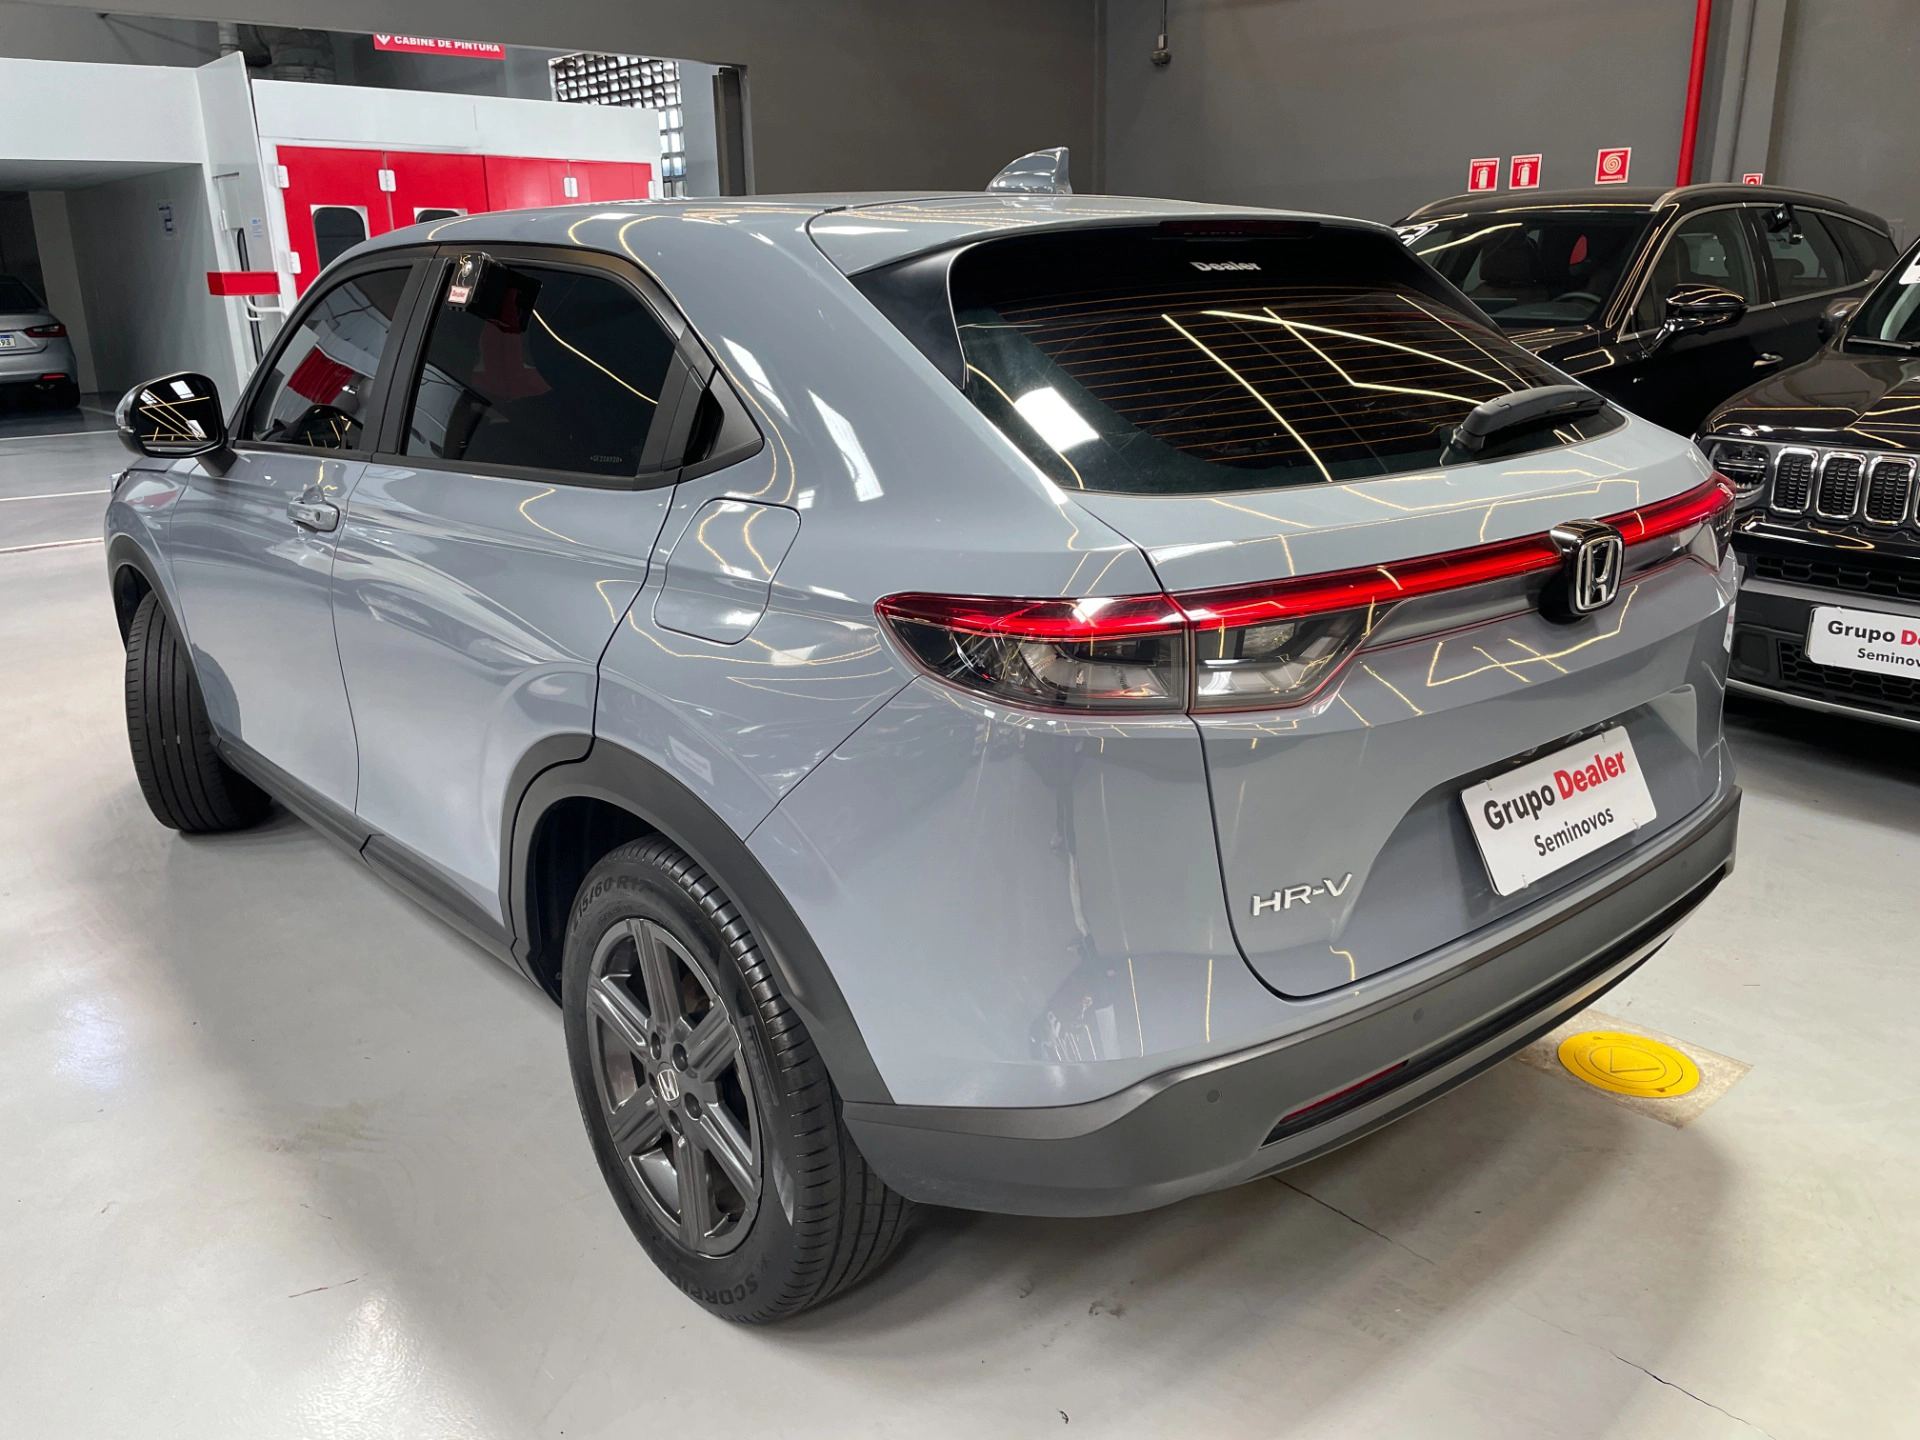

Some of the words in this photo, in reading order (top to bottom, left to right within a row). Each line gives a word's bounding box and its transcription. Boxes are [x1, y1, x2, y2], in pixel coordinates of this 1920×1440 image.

[394, 35, 435, 47] CABINE
[437, 39, 453, 48] DE
[454, 41, 501, 53] PINTURA
[1189, 260, 1262, 271] Dealer
[1827, 620, 1896, 643] Grupo
[1900, 629, 1920, 646] D
[1483, 784, 1556, 831] Grupo
[1553, 750, 1627, 800] Dealer
[1533, 808, 1614, 857] Seminovos
[1251, 873, 1353, 916] HR-V
[662, 1269, 760, 1306] SCORPIO
